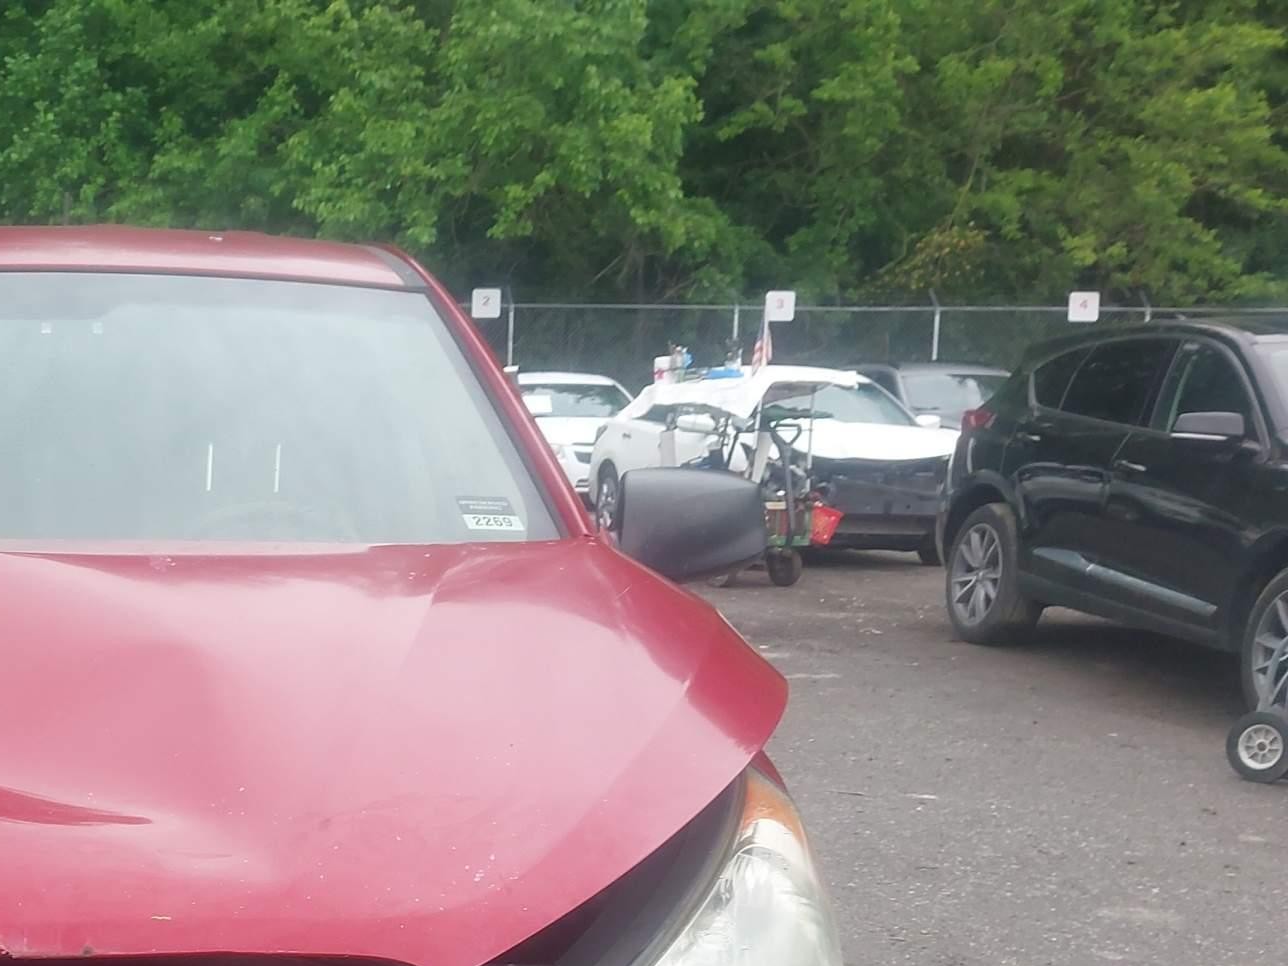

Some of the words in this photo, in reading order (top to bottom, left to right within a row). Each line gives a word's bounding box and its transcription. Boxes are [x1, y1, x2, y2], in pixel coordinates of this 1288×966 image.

[481, 295, 490, 306] 2
[775, 298, 784, 310] 3
[1080, 299, 1088, 310] 4
[471, 516, 513, 527] 2269
